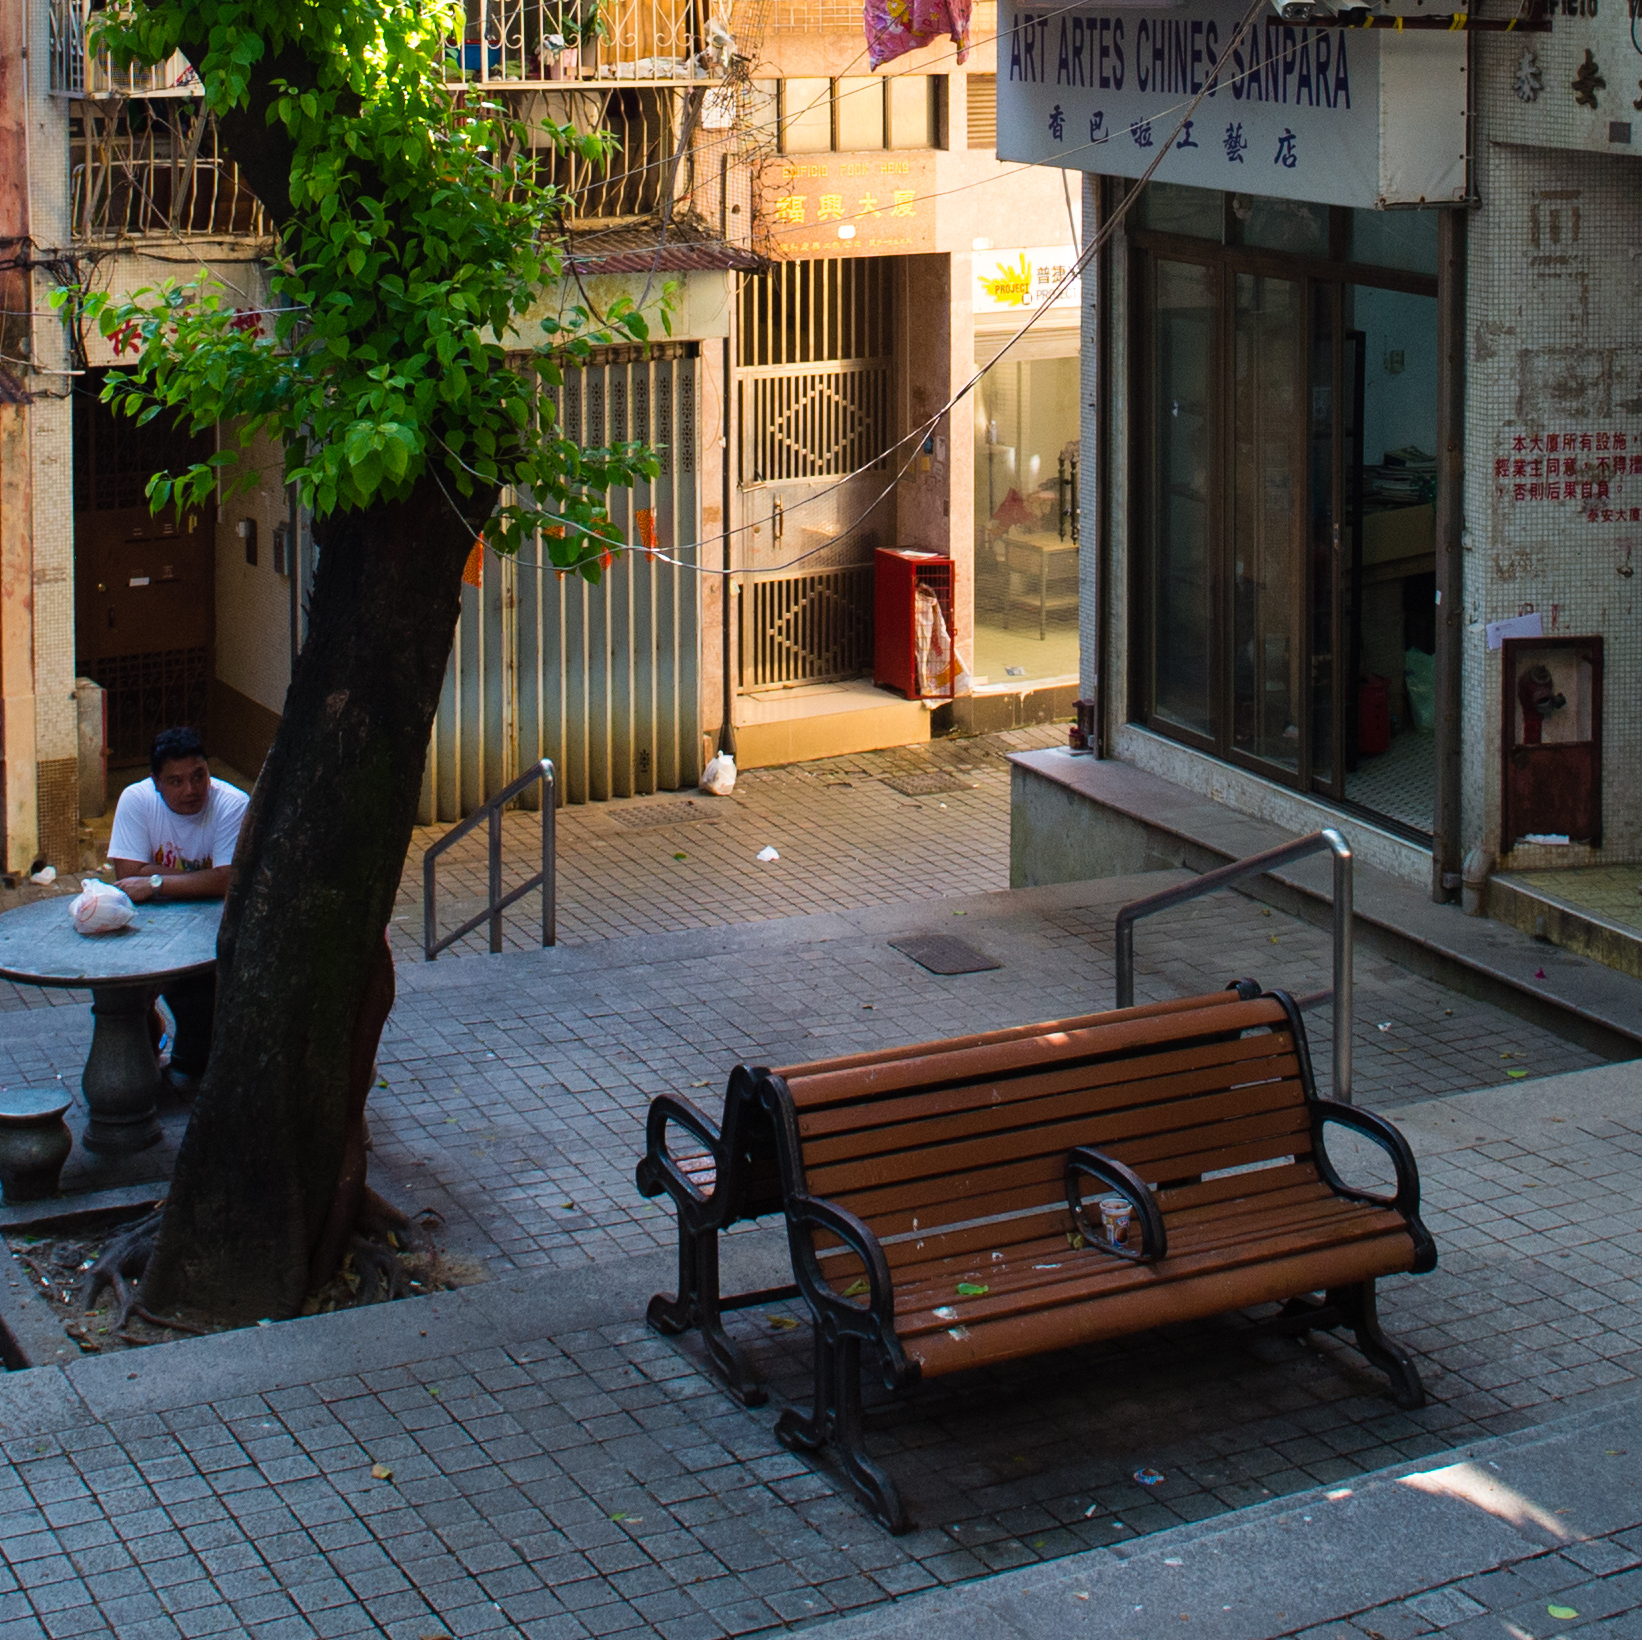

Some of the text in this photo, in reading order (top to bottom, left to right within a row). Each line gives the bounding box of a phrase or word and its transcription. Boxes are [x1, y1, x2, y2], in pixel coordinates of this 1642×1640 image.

[1010, 13, 1351, 109] ART ARTES CHINES SANPARA
[880, 161, 909, 175] HENG
[995, 283, 1029, 295] PROJECT
